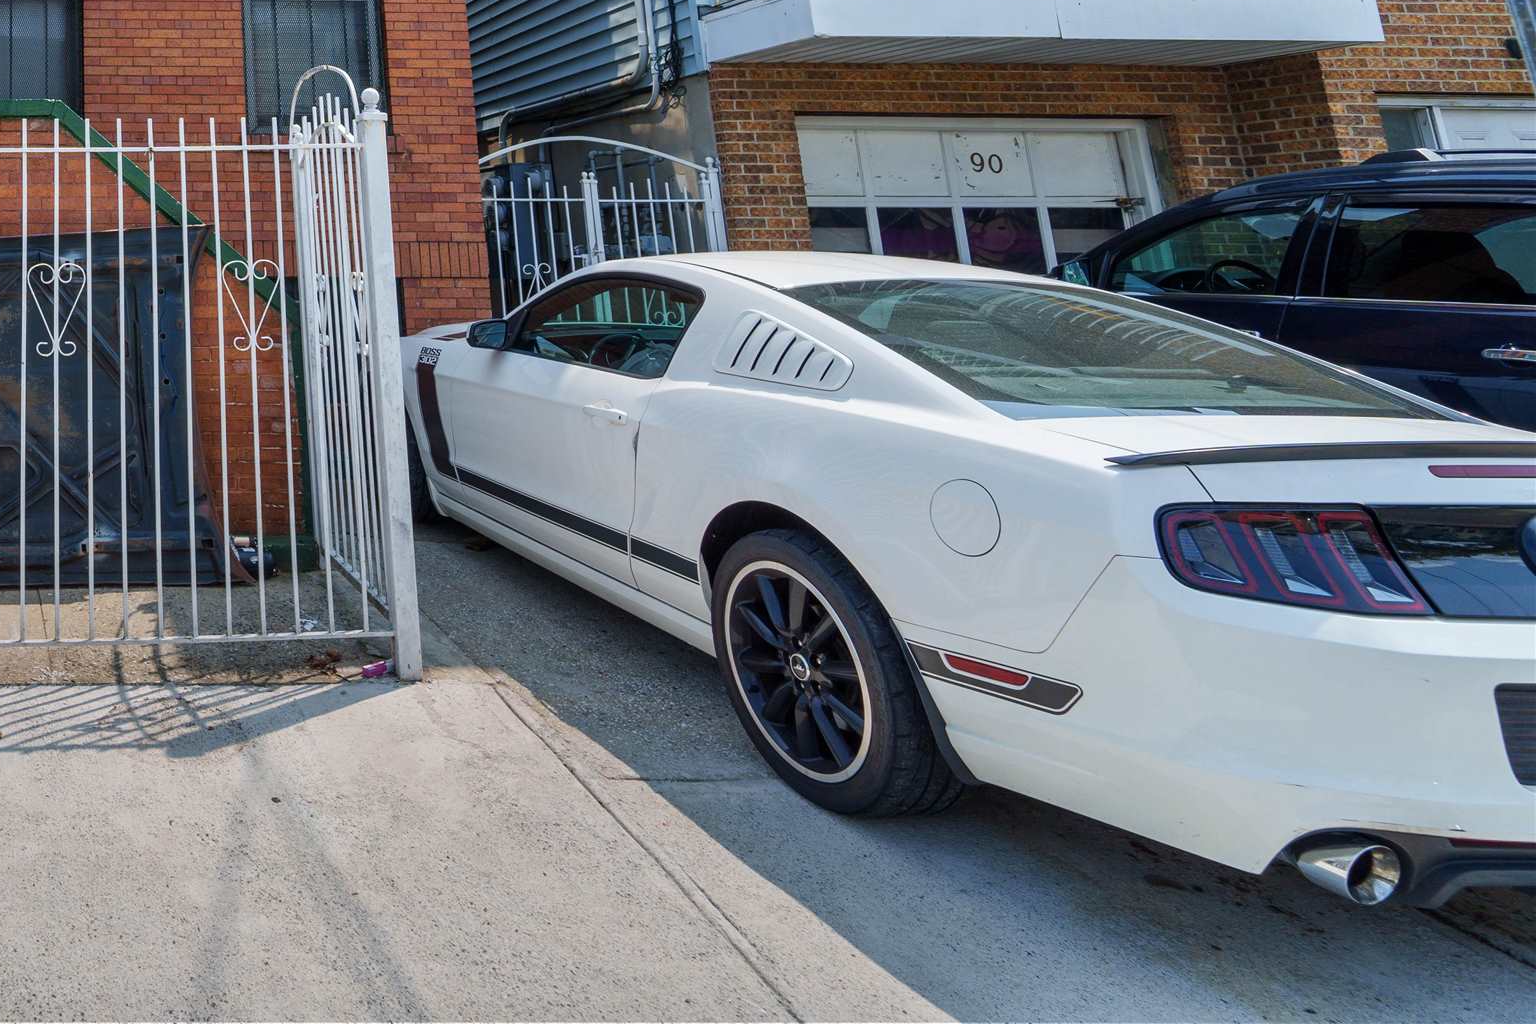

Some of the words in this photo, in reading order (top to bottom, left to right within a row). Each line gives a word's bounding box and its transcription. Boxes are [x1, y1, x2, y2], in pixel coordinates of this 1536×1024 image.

[970, 152, 1003, 174] 90
[420, 346, 442, 357] BOSS
[418, 356, 439, 366] 302
